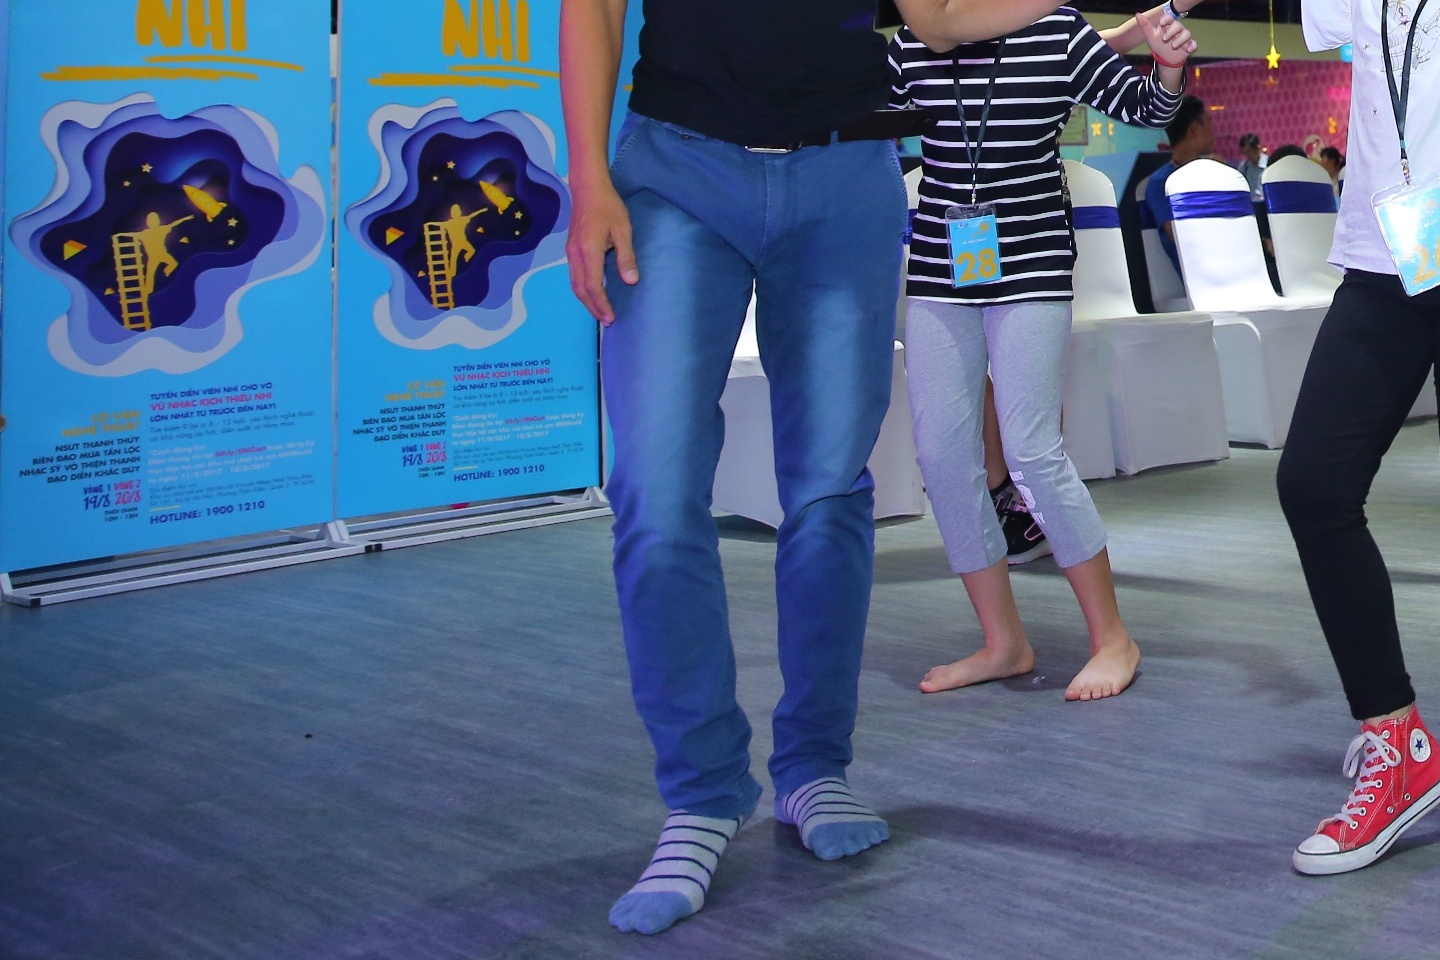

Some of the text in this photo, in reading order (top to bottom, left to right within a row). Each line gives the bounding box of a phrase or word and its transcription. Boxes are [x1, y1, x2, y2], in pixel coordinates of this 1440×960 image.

[956, 248, 997, 283] 28
[241, 383, 258, 391] CHO
[83, 440, 114, 449] THANH
[110, 456, 140, 466] THANH
[402, 453, 423, 467] 19/8
[426, 451, 447, 463] 20/8
[122, 466, 140, 474] DUY
[498, 467, 520, 476] 1900
[523, 464, 545, 474] 1210
[84, 494, 110, 511] 19/8
[114, 490, 141, 505] 20/8
[206, 505, 234, 516] 1900
[238, 501, 265, 512] 1210
